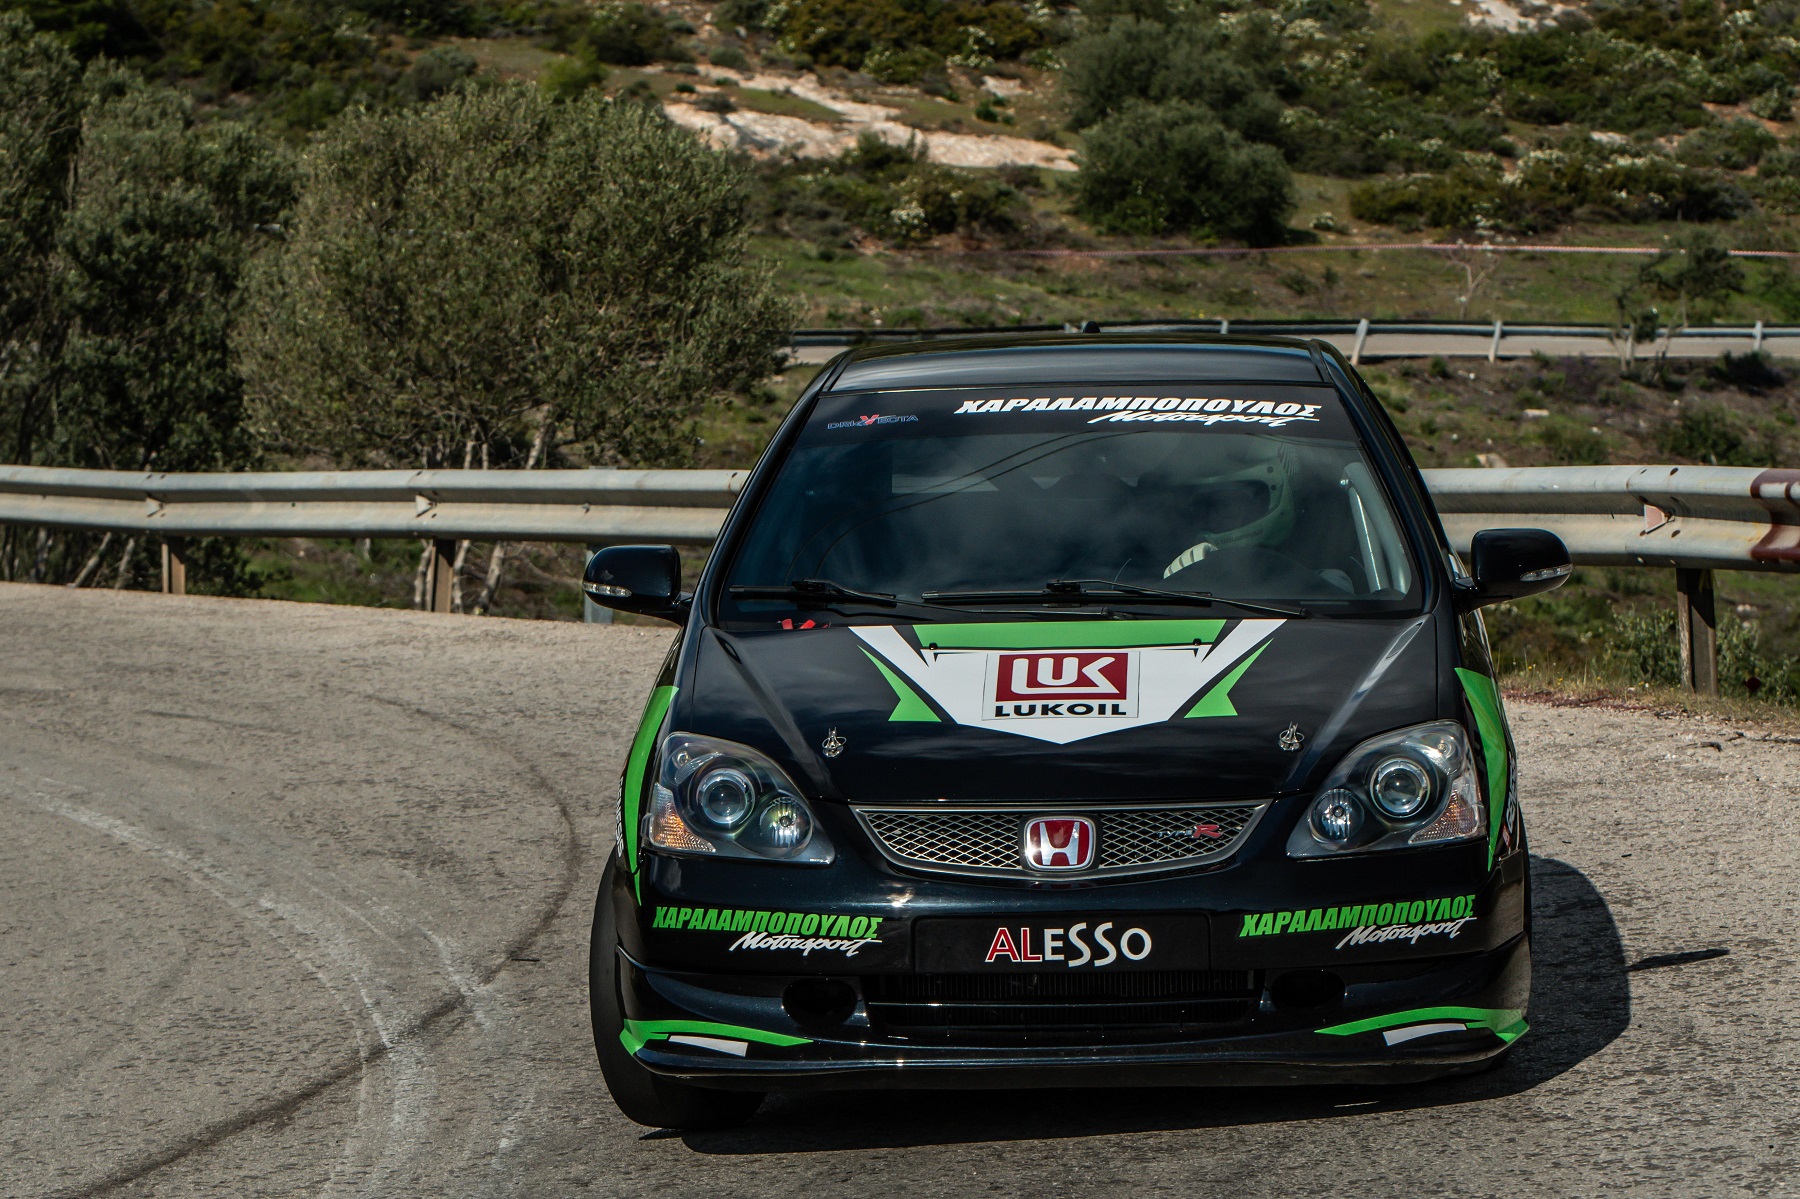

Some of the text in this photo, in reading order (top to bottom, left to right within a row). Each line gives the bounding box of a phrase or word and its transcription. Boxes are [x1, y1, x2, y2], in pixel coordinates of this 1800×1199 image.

[953, 396, 1322, 417] ΧΑΡΑΛΑΜΠΟΠΟΥΛΟΣ
[1087, 410, 1320, 427] Motorsport
[995, 703, 1127, 717] LUKOIL
[652, 906, 884, 938] ΧΑΡΑΛΑΜΠΟΠΟΥΛΟΣ
[1239, 894, 1477, 938] ΧΑΡΑΛΑΜΠΟΠΟΥΛΟΣ
[729, 931, 883, 957] Motorsport
[984, 921, 1152, 968] ALESSO
[1334, 916, 1478, 950] Motorsport
